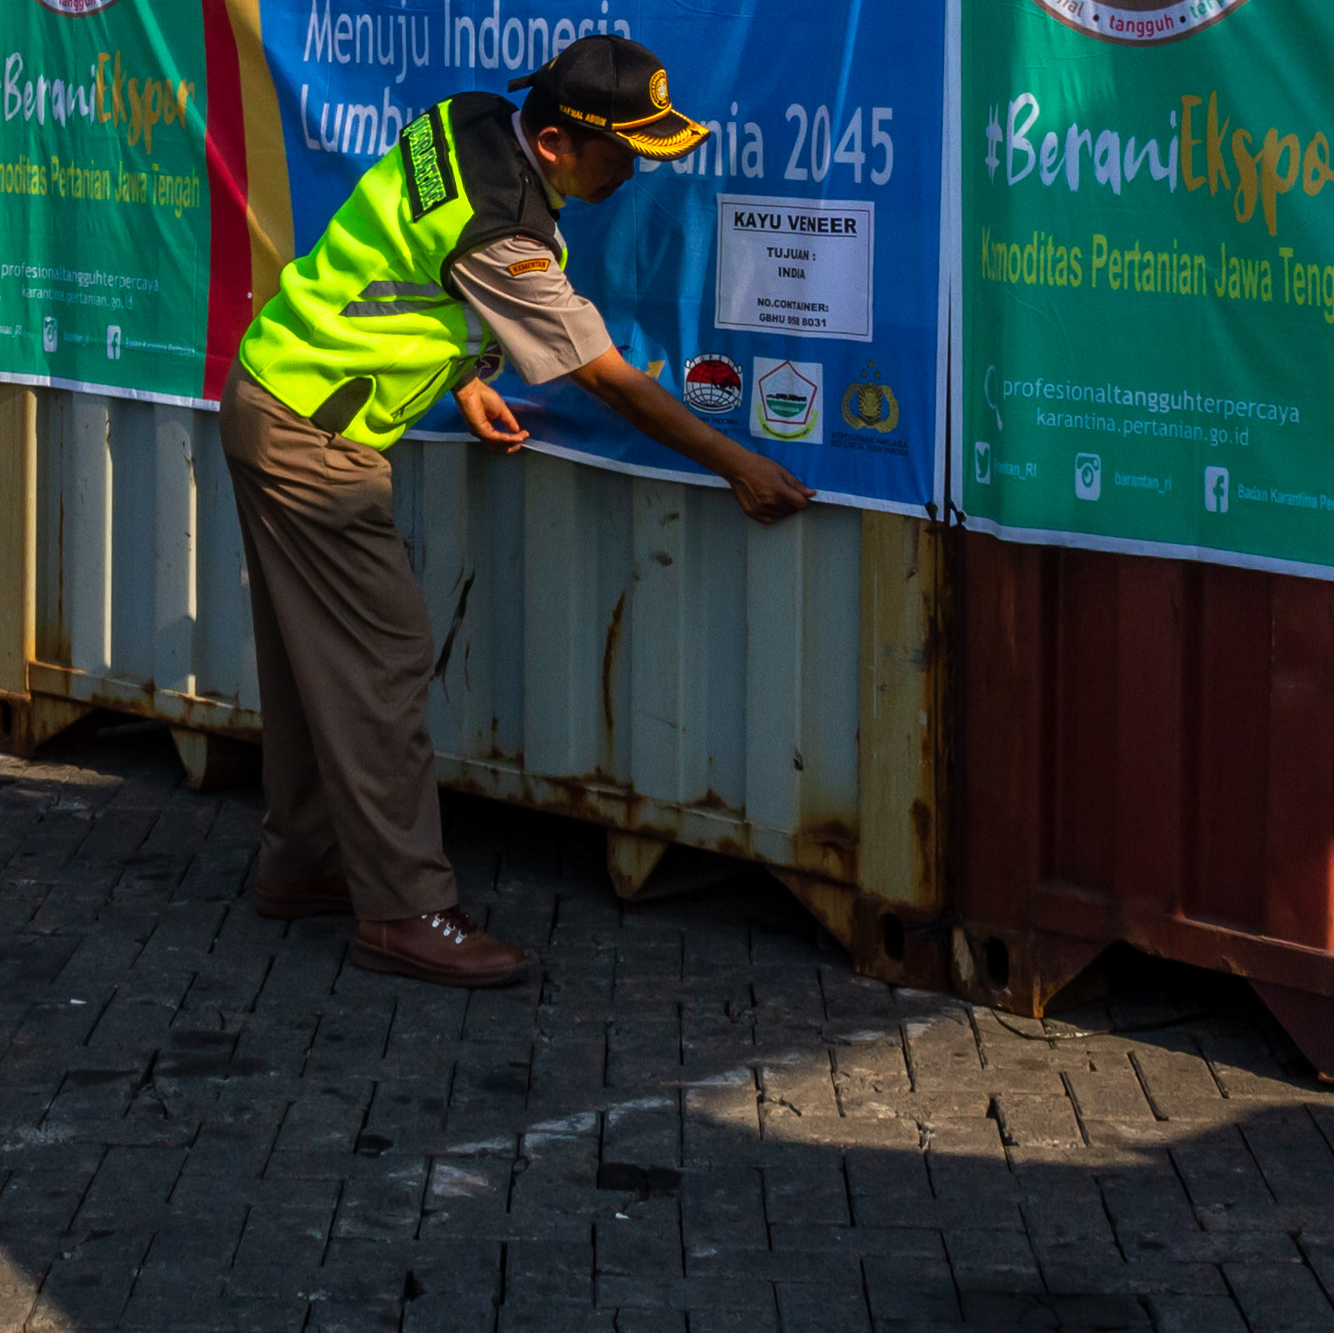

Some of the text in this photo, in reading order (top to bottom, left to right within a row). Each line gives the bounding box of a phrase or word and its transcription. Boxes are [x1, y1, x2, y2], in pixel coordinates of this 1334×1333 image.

[1108, 14, 1175, 38] tangguh
[784, 103, 895, 185] 2045
[51, 156, 111, 201] Pertanian
[114, 161, 147, 203] Jawa
[151, 163, 200, 218] Tengah
[734, 212, 857, 234] KAYU VENEER
[767, 247, 809, 261] TUJUAN
[1091, 234, 1207, 297] Pertanian
[1214, 242, 1273, 303] Jawa
[778, 267, 806, 279] INDIA
[1003, 377, 1301, 425] profesionaltangguhterpercaya
[1036, 407, 1250, 447] karantina.pertanian.go.id
[1237, 483, 1268, 504] Badan
[1270, 489, 1318, 510] Karantina
